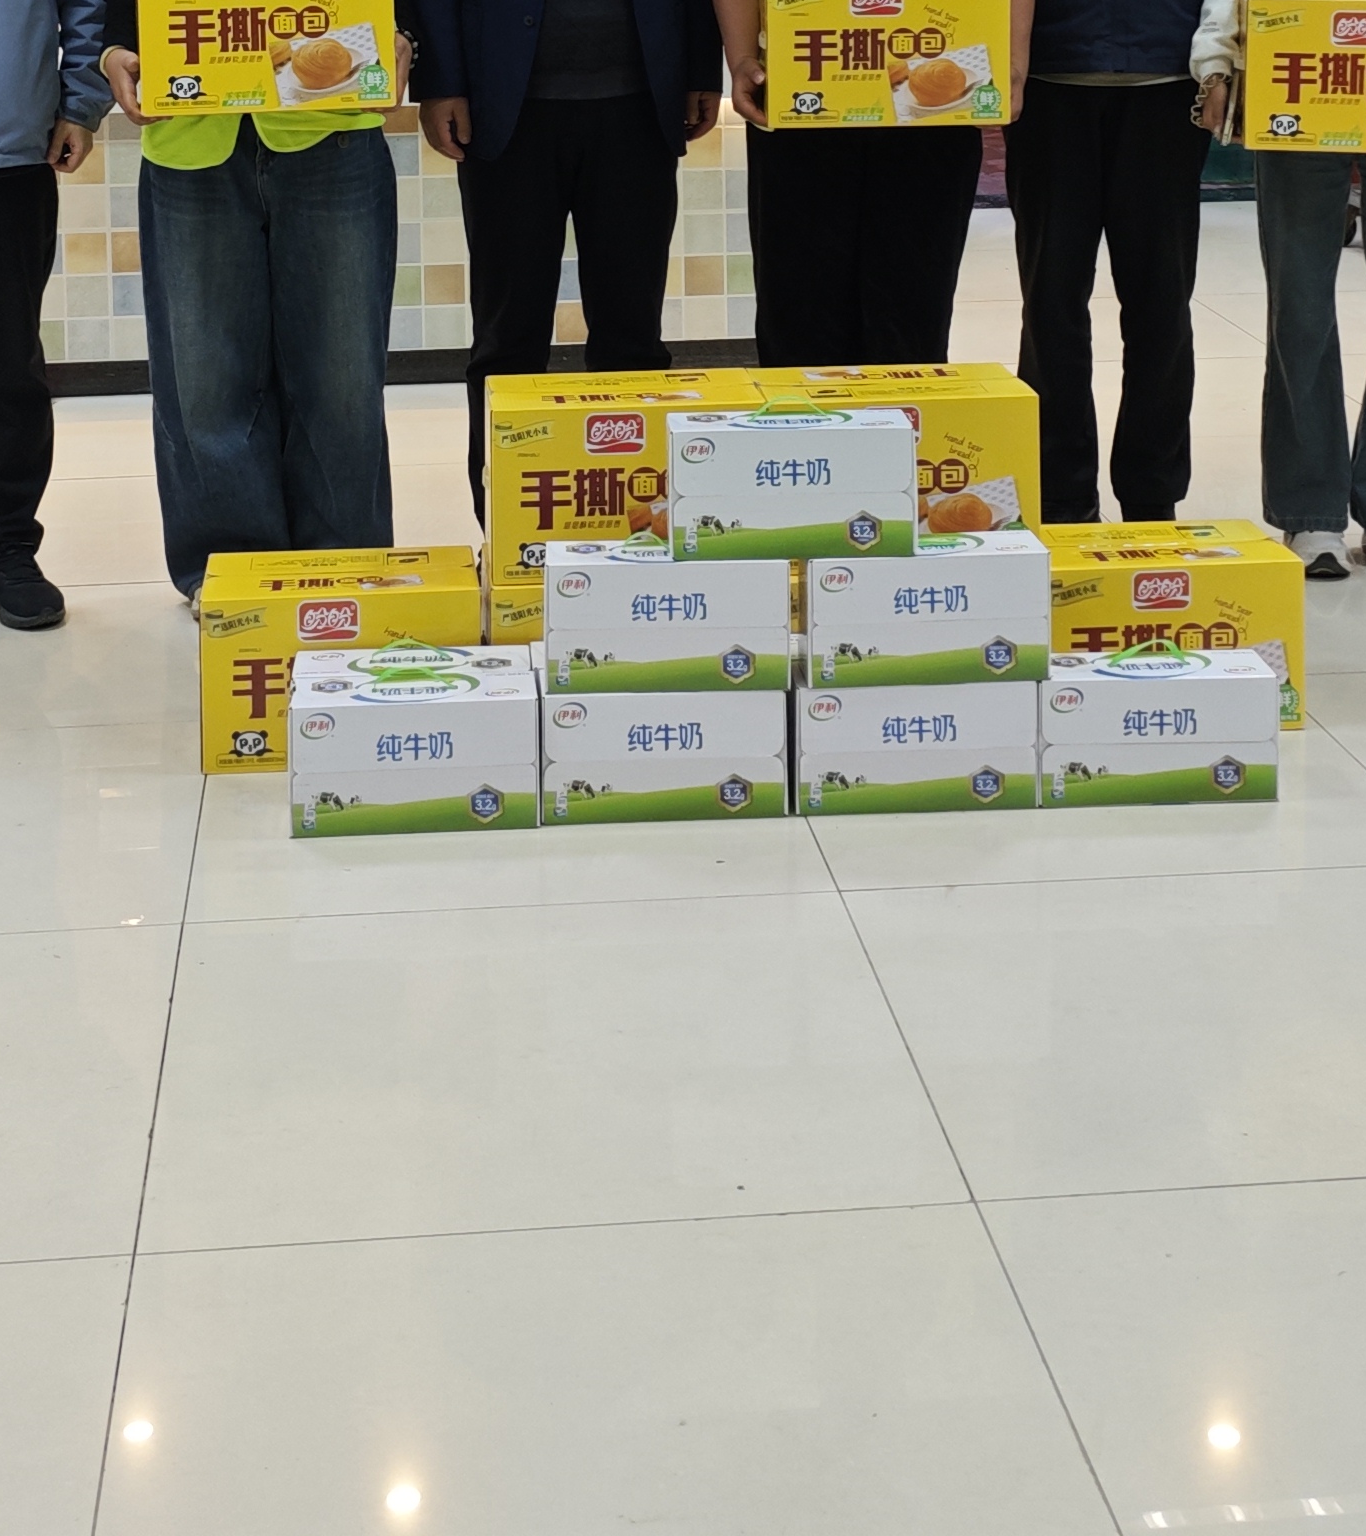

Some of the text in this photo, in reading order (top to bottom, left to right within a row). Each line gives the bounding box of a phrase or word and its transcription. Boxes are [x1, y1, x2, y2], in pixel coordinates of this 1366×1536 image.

[168, 7, 327, 65] 手撕面包
[793, 28, 944, 82] 手撕面包
[501, 424, 549, 444] 严选阳光小麦
[588, 418, 641, 443] 盼盼
[686, 444, 710, 457] 伊利
[755, 458, 831, 487] 纯牛奶
[520, 467, 660, 531] 手撕面
[852, 525, 875, 540] 3.2g
[561, 578, 586, 591] 伊利
[824, 573, 849, 585] 伊利
[1136, 577, 1186, 600] 盼盼
[631, 593, 707, 622] 纯牛奶
[893, 585, 969, 615] 纯牛奶
[302, 606, 354, 631] 盼盼
[502, 605, 543, 623] 严选阳光小
[988, 650, 1010, 663] 3.2g
[725, 659, 748, 673] 3.2g
[812, 702, 837, 715] 伊利
[1055, 694, 1079, 707] 伊利
[557, 709, 582, 722] 伊利
[1122, 708, 1198, 737] 纯牛奶
[305, 720, 330, 733] 伊利
[882, 714, 957, 744] 纯牛奶
[628, 722, 704, 752] 纯牛奶
[376, 731, 454, 762] 纯牛奶
[975, 779, 997, 792] 3.2g
[1217, 770, 1239, 783] 3.2g
[723, 788, 745, 801] 3.2g
[474, 799, 497, 812] 3.2g
